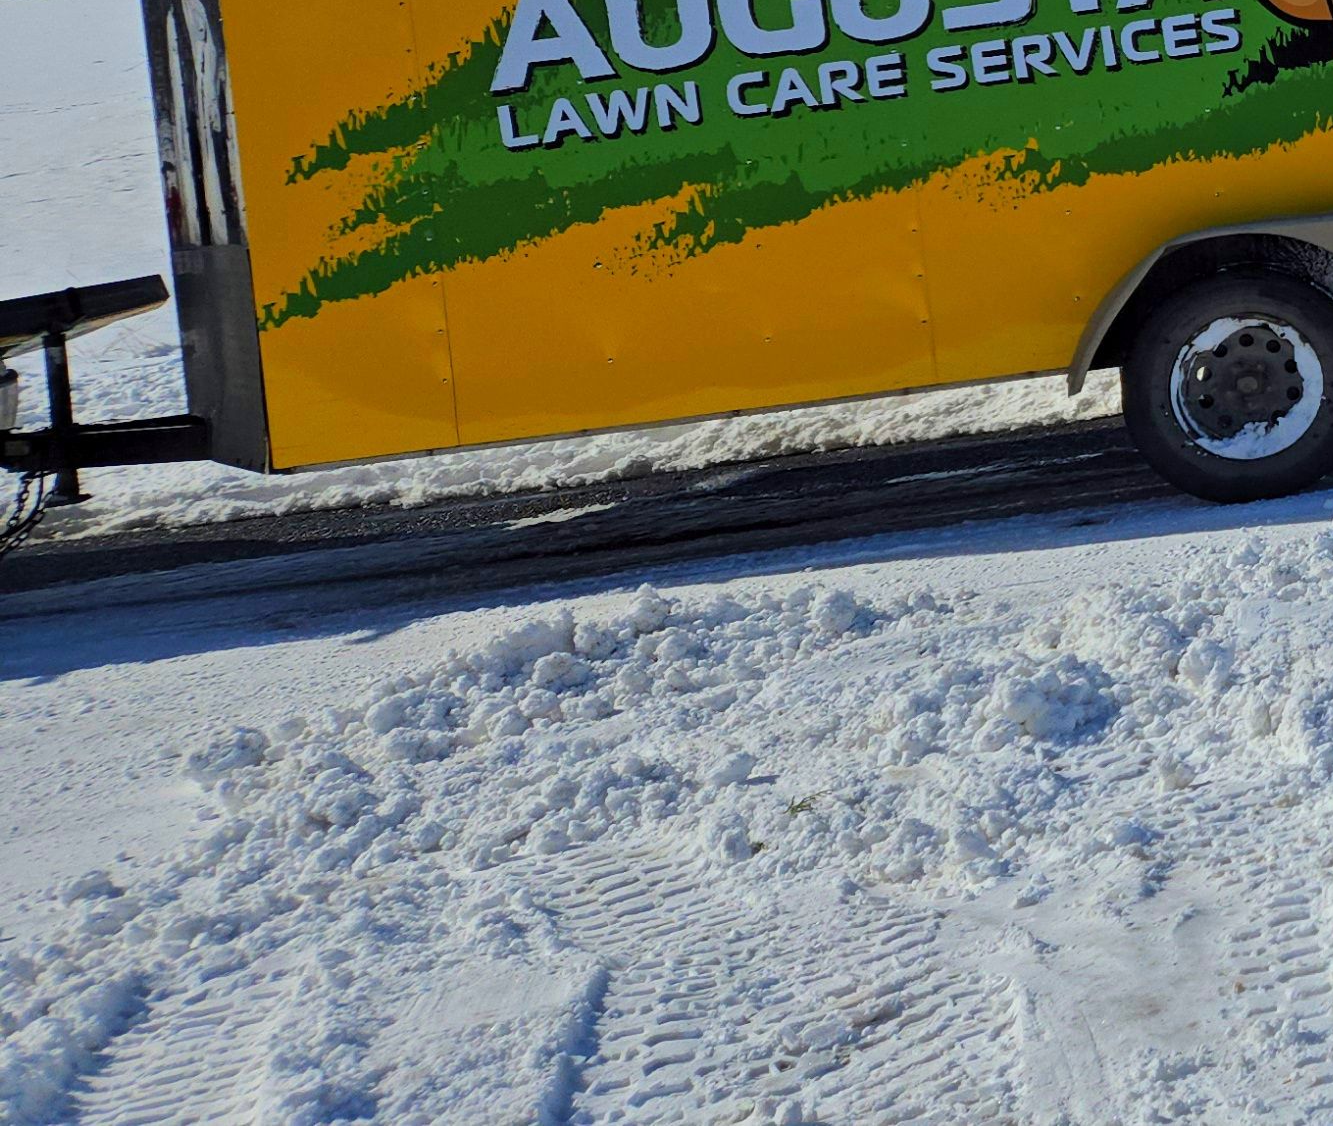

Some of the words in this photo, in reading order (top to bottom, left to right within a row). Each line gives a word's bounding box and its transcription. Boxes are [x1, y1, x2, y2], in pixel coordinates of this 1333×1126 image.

[496, 80, 704, 152] LAWN
[726, 52, 907, 117] CARE
[926, 8, 1242, 92] SERVICES
